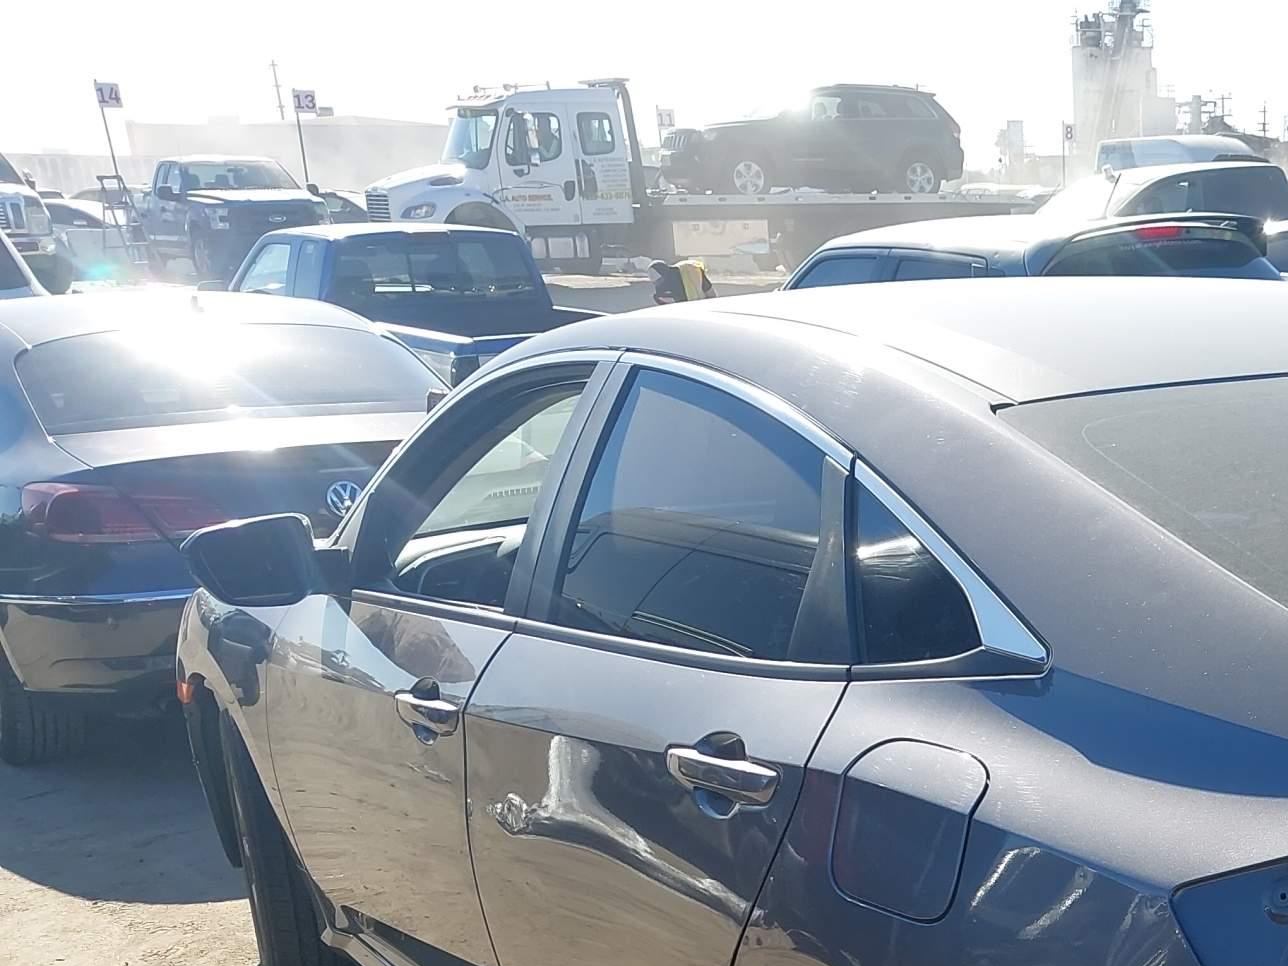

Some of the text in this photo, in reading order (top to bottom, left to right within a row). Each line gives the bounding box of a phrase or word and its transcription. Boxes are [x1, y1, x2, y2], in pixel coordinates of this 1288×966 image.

[95, 86, 121, 105] 14
[293, 93, 316, 110] 13
[1065, 125, 1073, 140] 8
